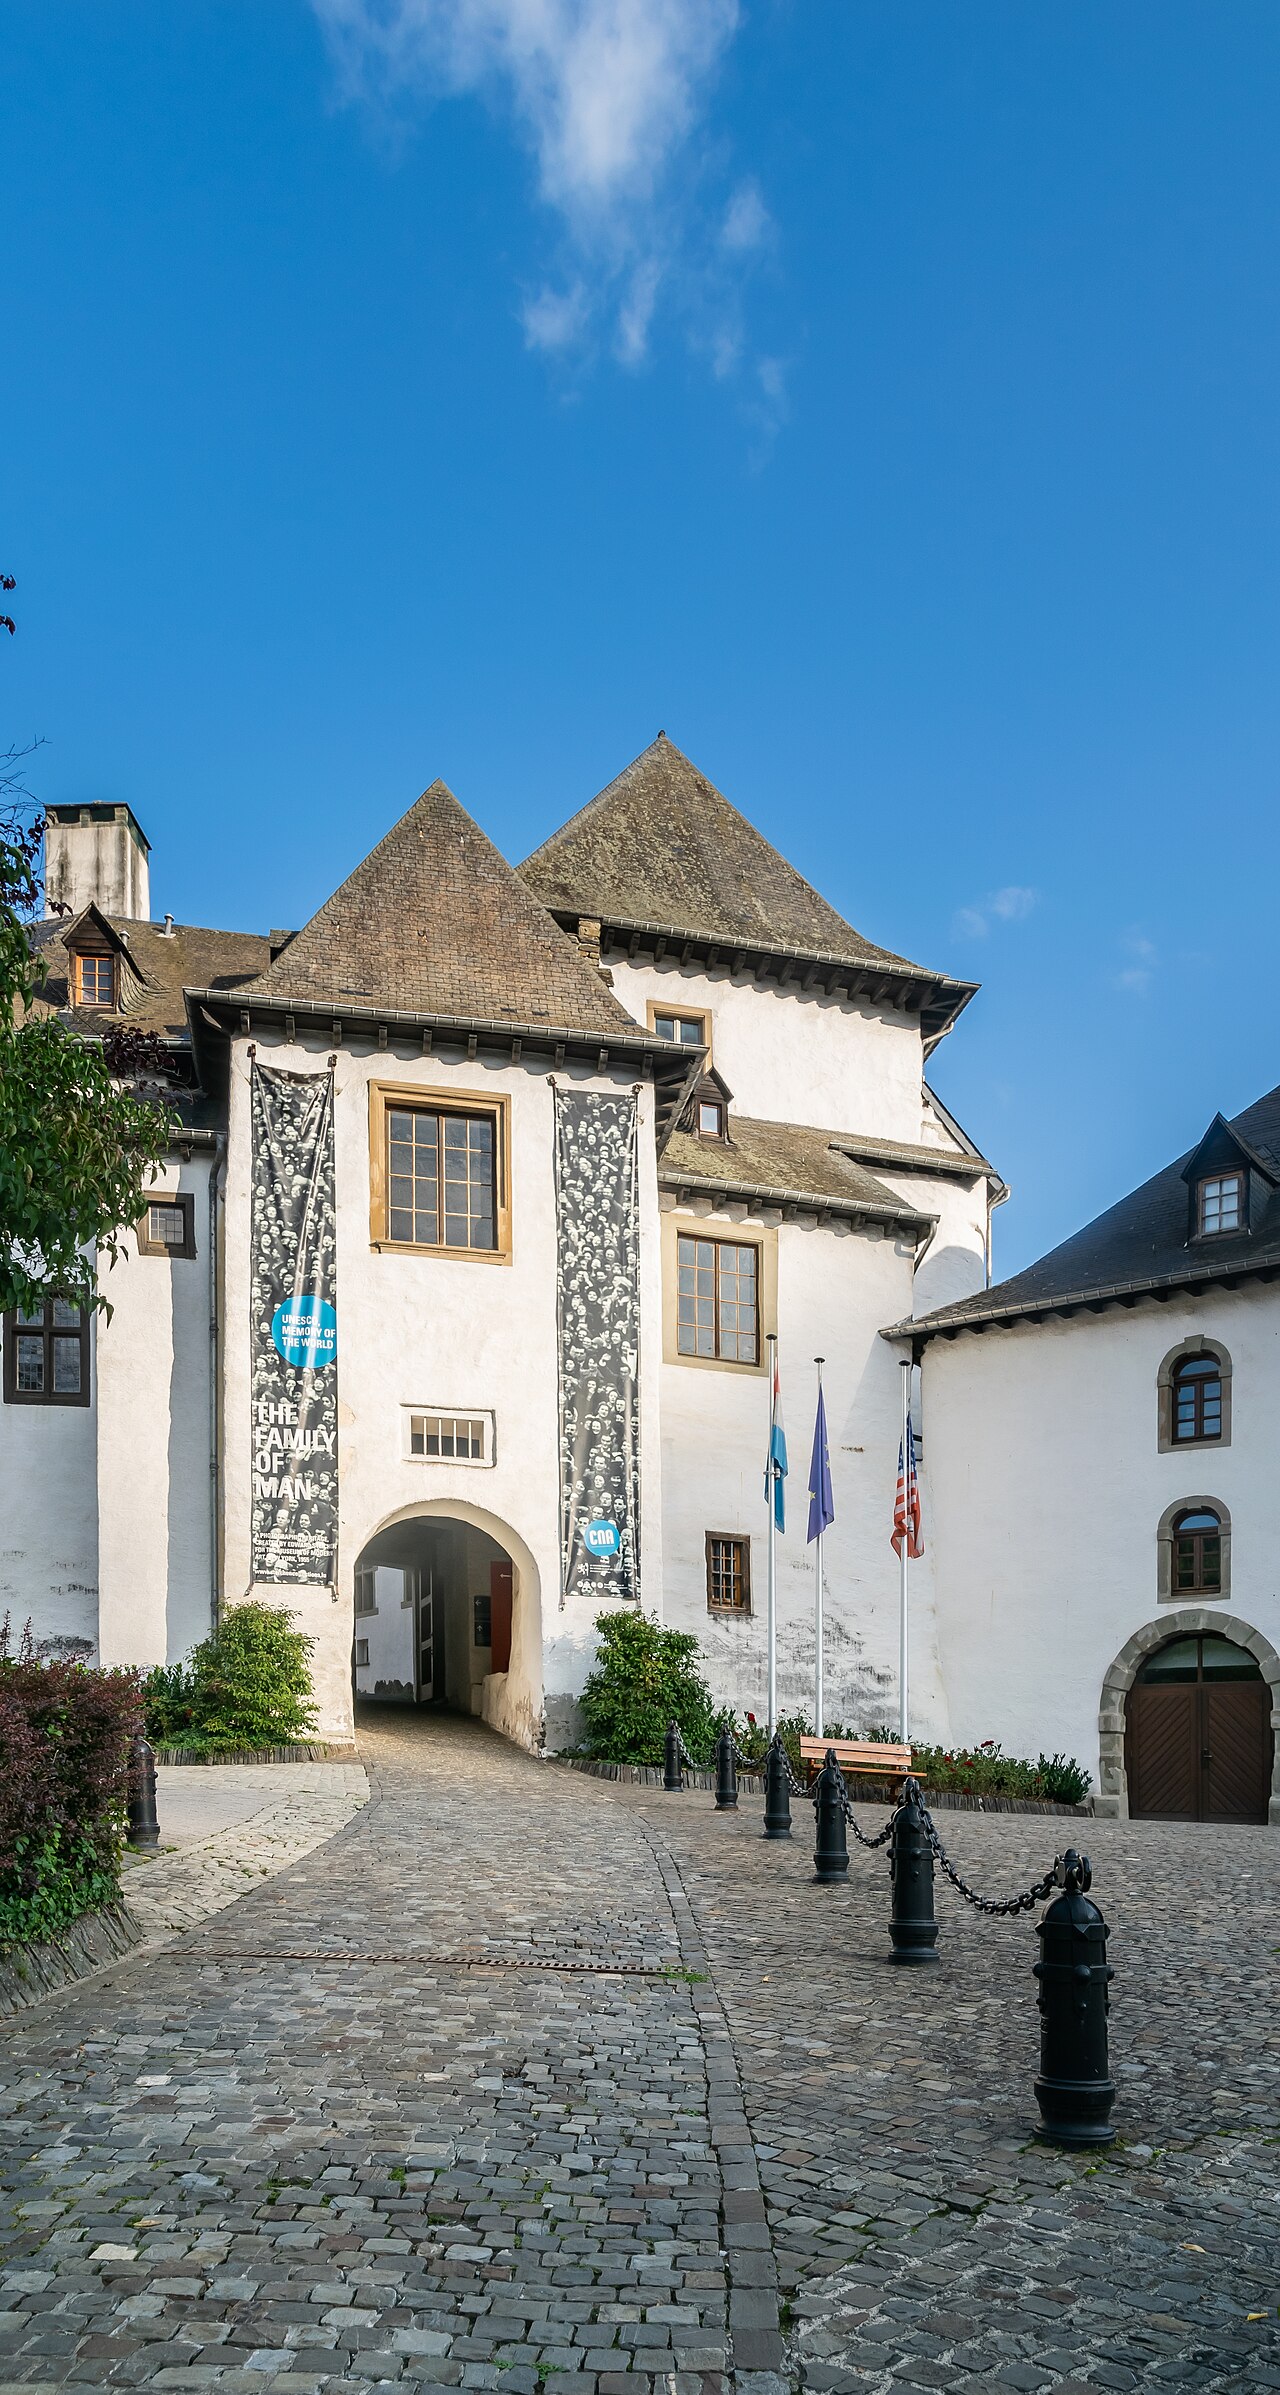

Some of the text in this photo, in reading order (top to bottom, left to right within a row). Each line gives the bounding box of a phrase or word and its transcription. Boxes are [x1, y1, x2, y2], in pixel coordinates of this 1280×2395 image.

[282, 1314, 320, 1327] UNESCO,
[282, 1326, 335, 1338] MEMORY OF
[282, 1337, 333, 1349] THE WORLD
[255, 1401, 298, 1425] THE
[255, 1426, 336, 1452] FAMILY
[255, 1451, 284, 1473] OF
[255, 1476, 312, 1500] MAN
[589, 1529, 614, 1545] CNA
